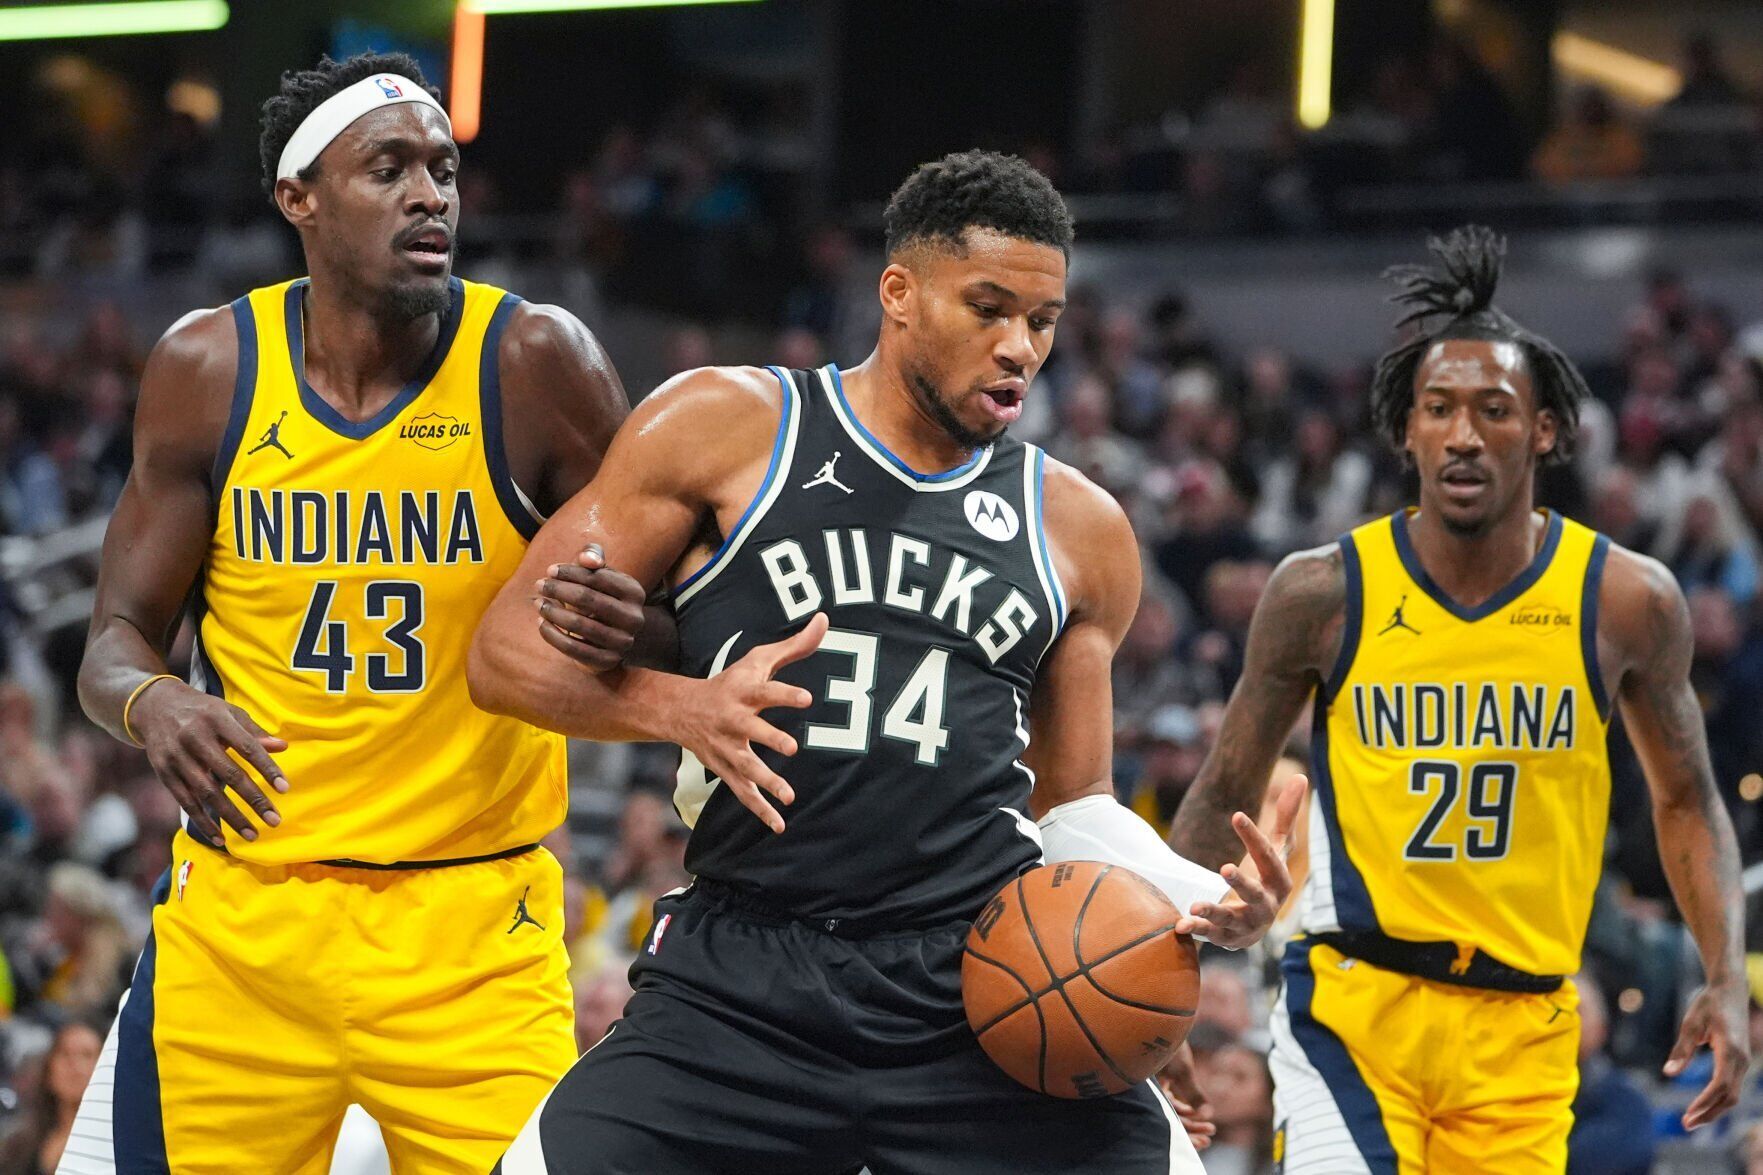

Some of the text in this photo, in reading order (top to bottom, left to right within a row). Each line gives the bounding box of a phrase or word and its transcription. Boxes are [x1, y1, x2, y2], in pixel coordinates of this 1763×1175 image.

[399, 422, 471, 439] LUCAS OIL
[232, 487, 484, 564] INDIANA
[290, 579, 426, 694] 43
[758, 528, 1040, 665] BUCKS
[804, 627, 953, 766] 34
[1352, 682, 1577, 750] INDIANA
[1402, 758, 1519, 862] 29
